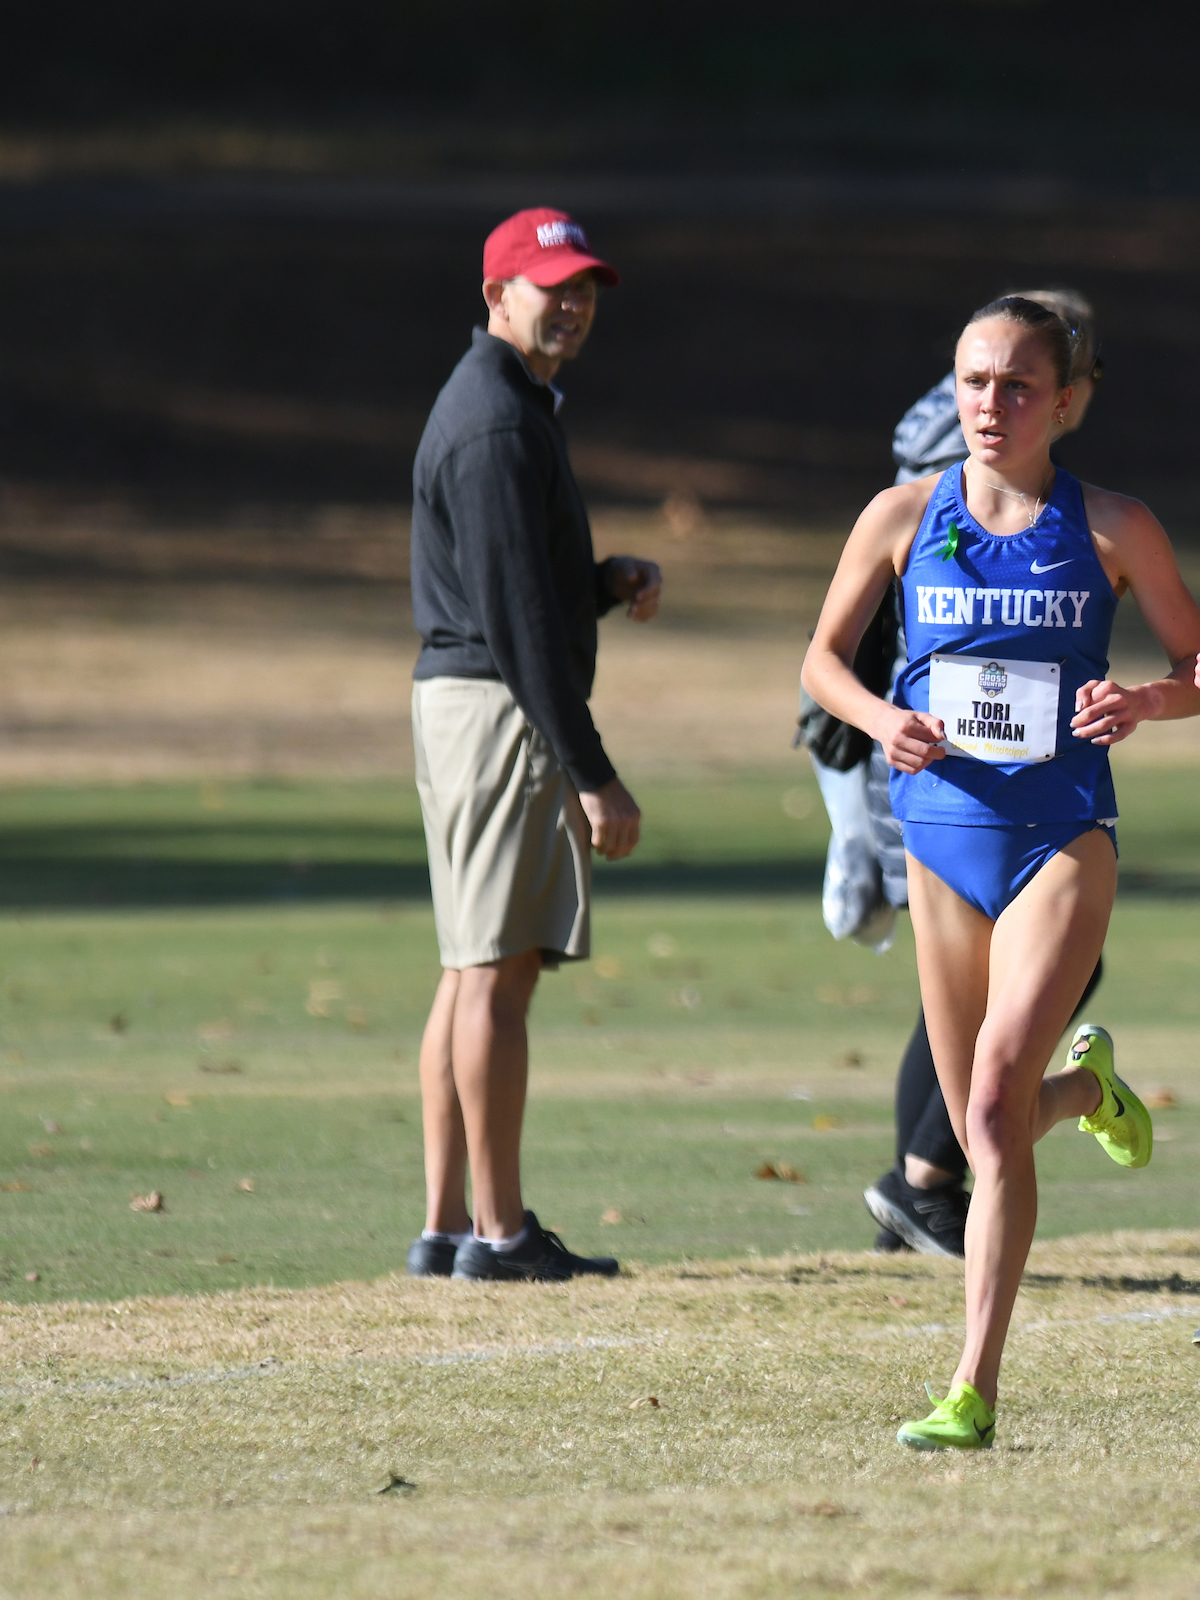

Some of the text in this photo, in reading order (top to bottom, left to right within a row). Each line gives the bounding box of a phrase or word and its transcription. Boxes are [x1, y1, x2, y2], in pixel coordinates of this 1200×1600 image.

[916, 585, 1090, 628] KENTUCKY
[979, 673, 1006, 682] CROSS
[972, 700, 1010, 721] TORI
[957, 718, 1025, 742] HERMAN
